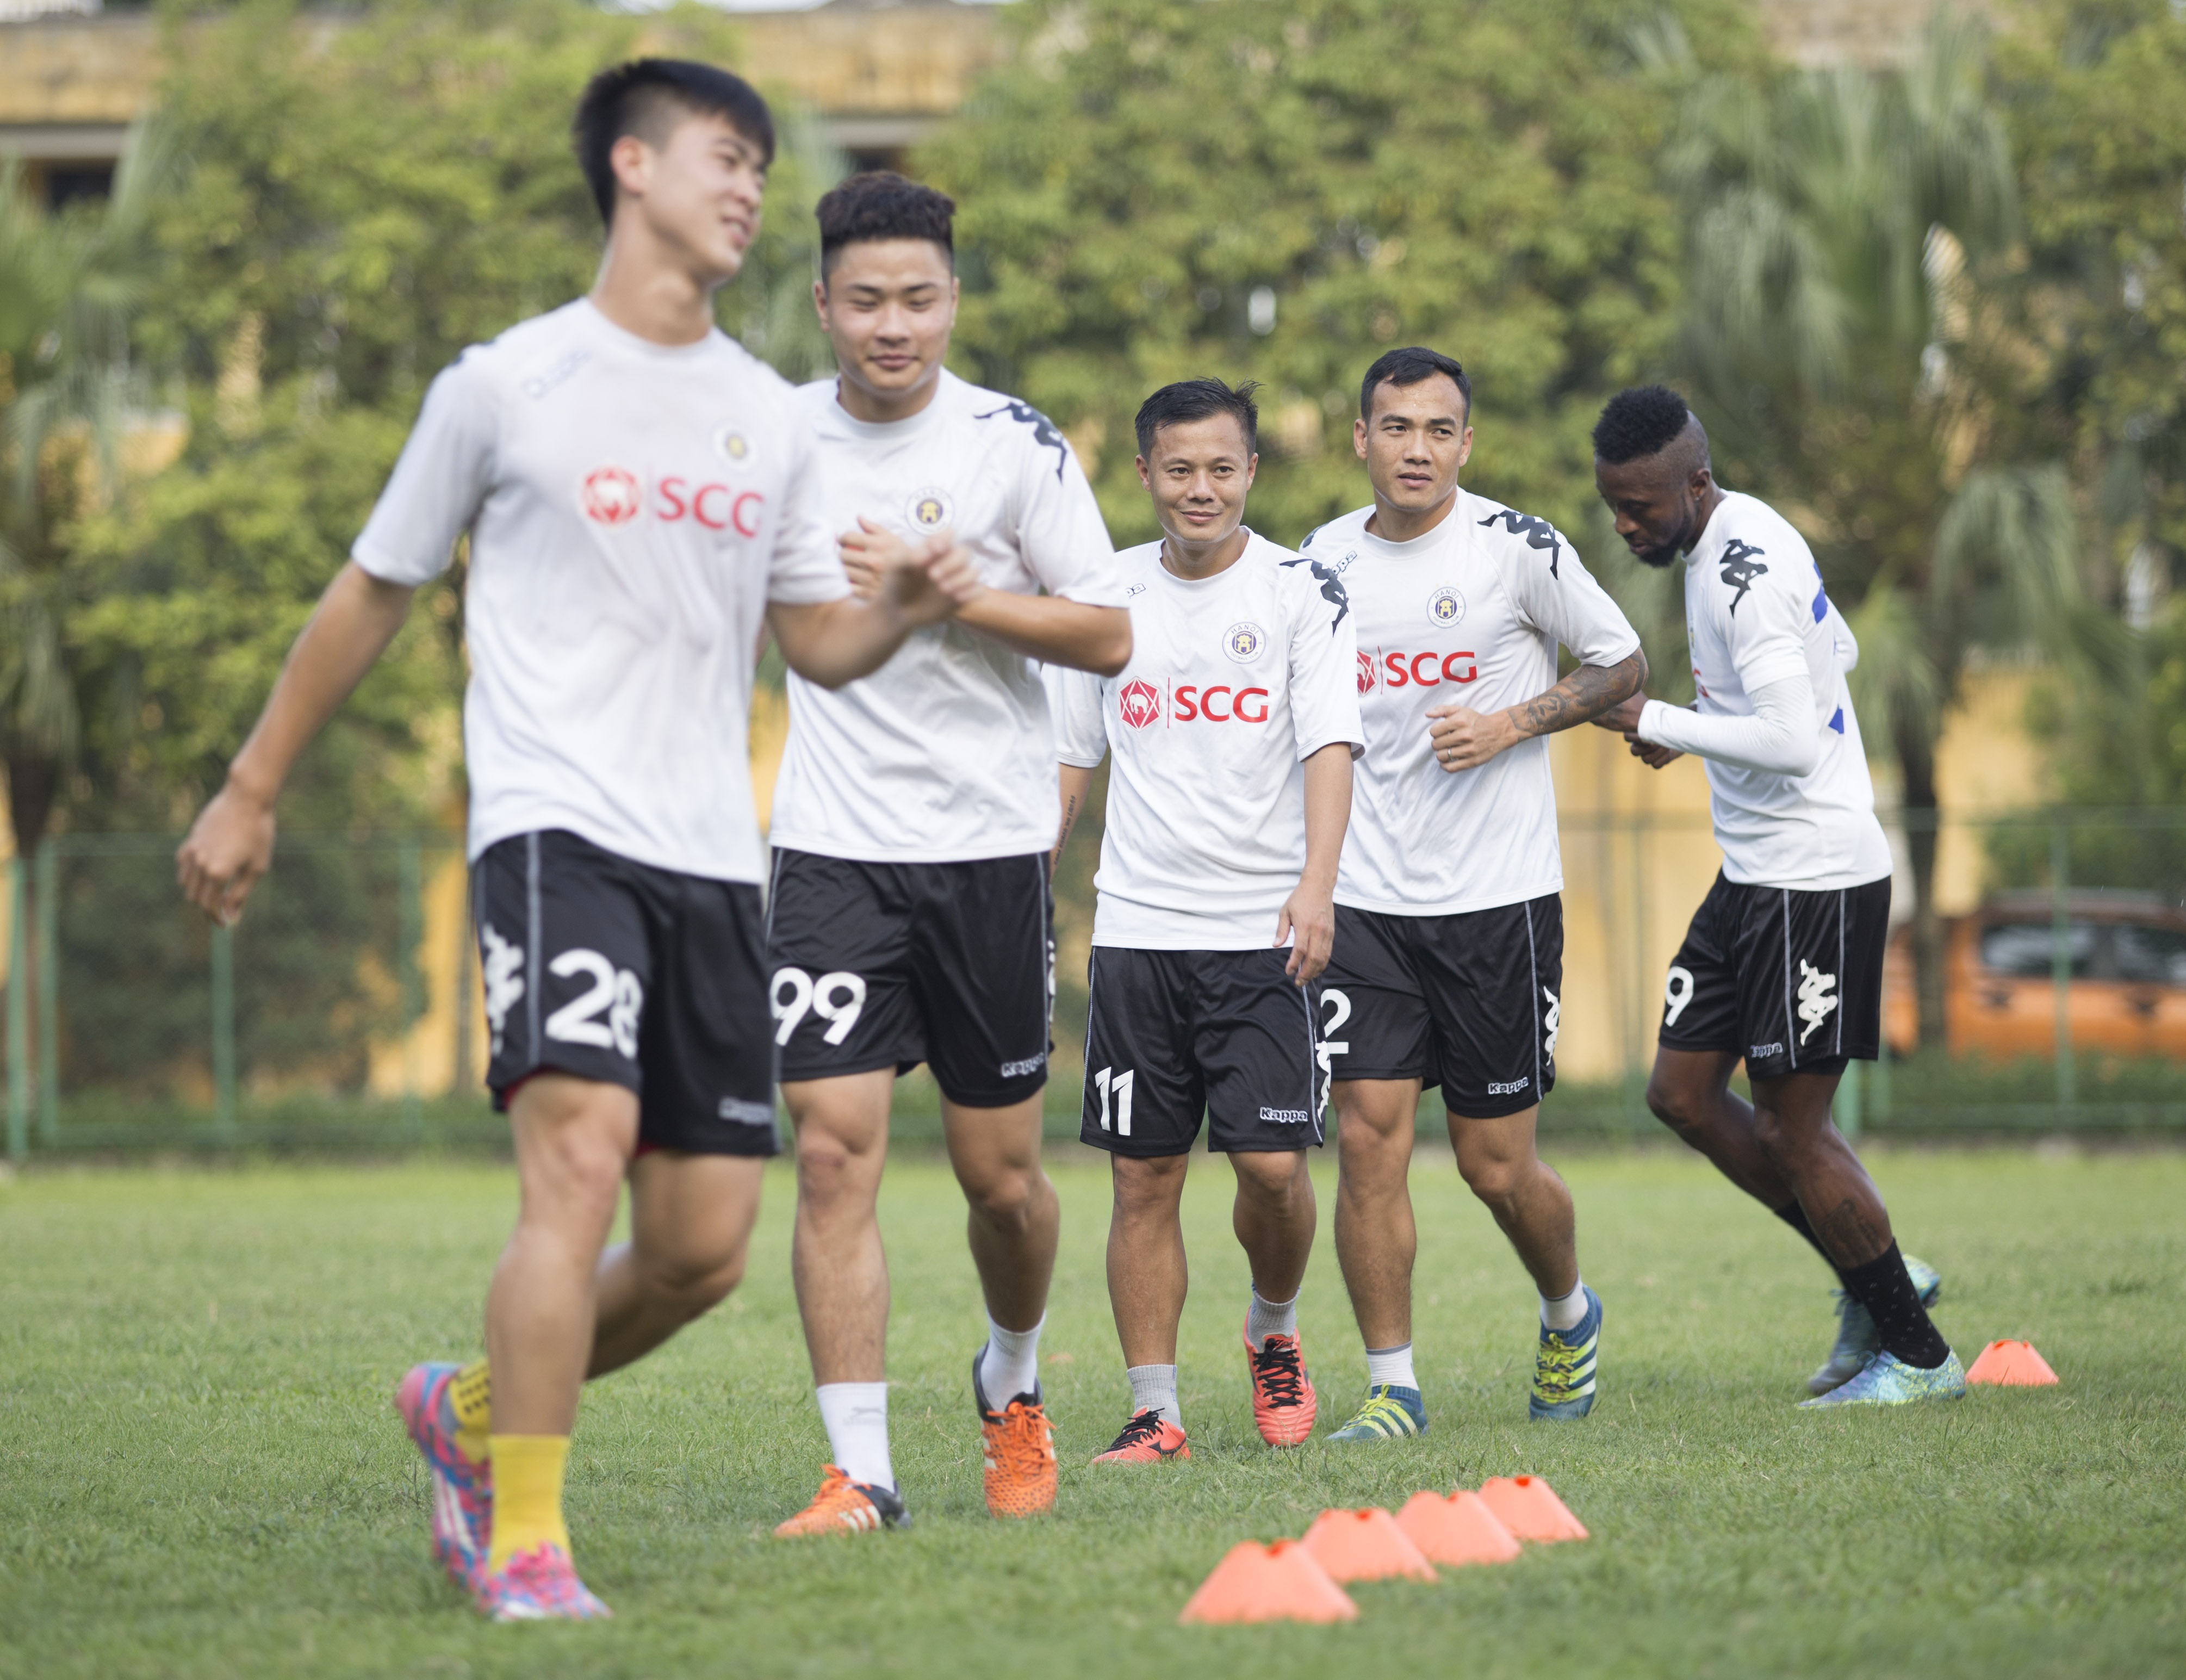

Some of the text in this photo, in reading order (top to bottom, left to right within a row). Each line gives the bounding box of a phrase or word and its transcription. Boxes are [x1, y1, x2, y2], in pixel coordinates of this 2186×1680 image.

[657, 476, 763, 540] SCG
[1434, 589, 1460, 599] HANOI
[1231, 624, 1259, 635] HANOI
[1385, 651, 1477, 687] SCG
[1175, 685, 1268, 723] SCG
[769, 966, 867, 1046] 99
[1095, 1066, 1134, 1136] 11
[1488, 1076, 1529, 1095] Kappa
[1260, 1106, 1308, 1123] Kappa
